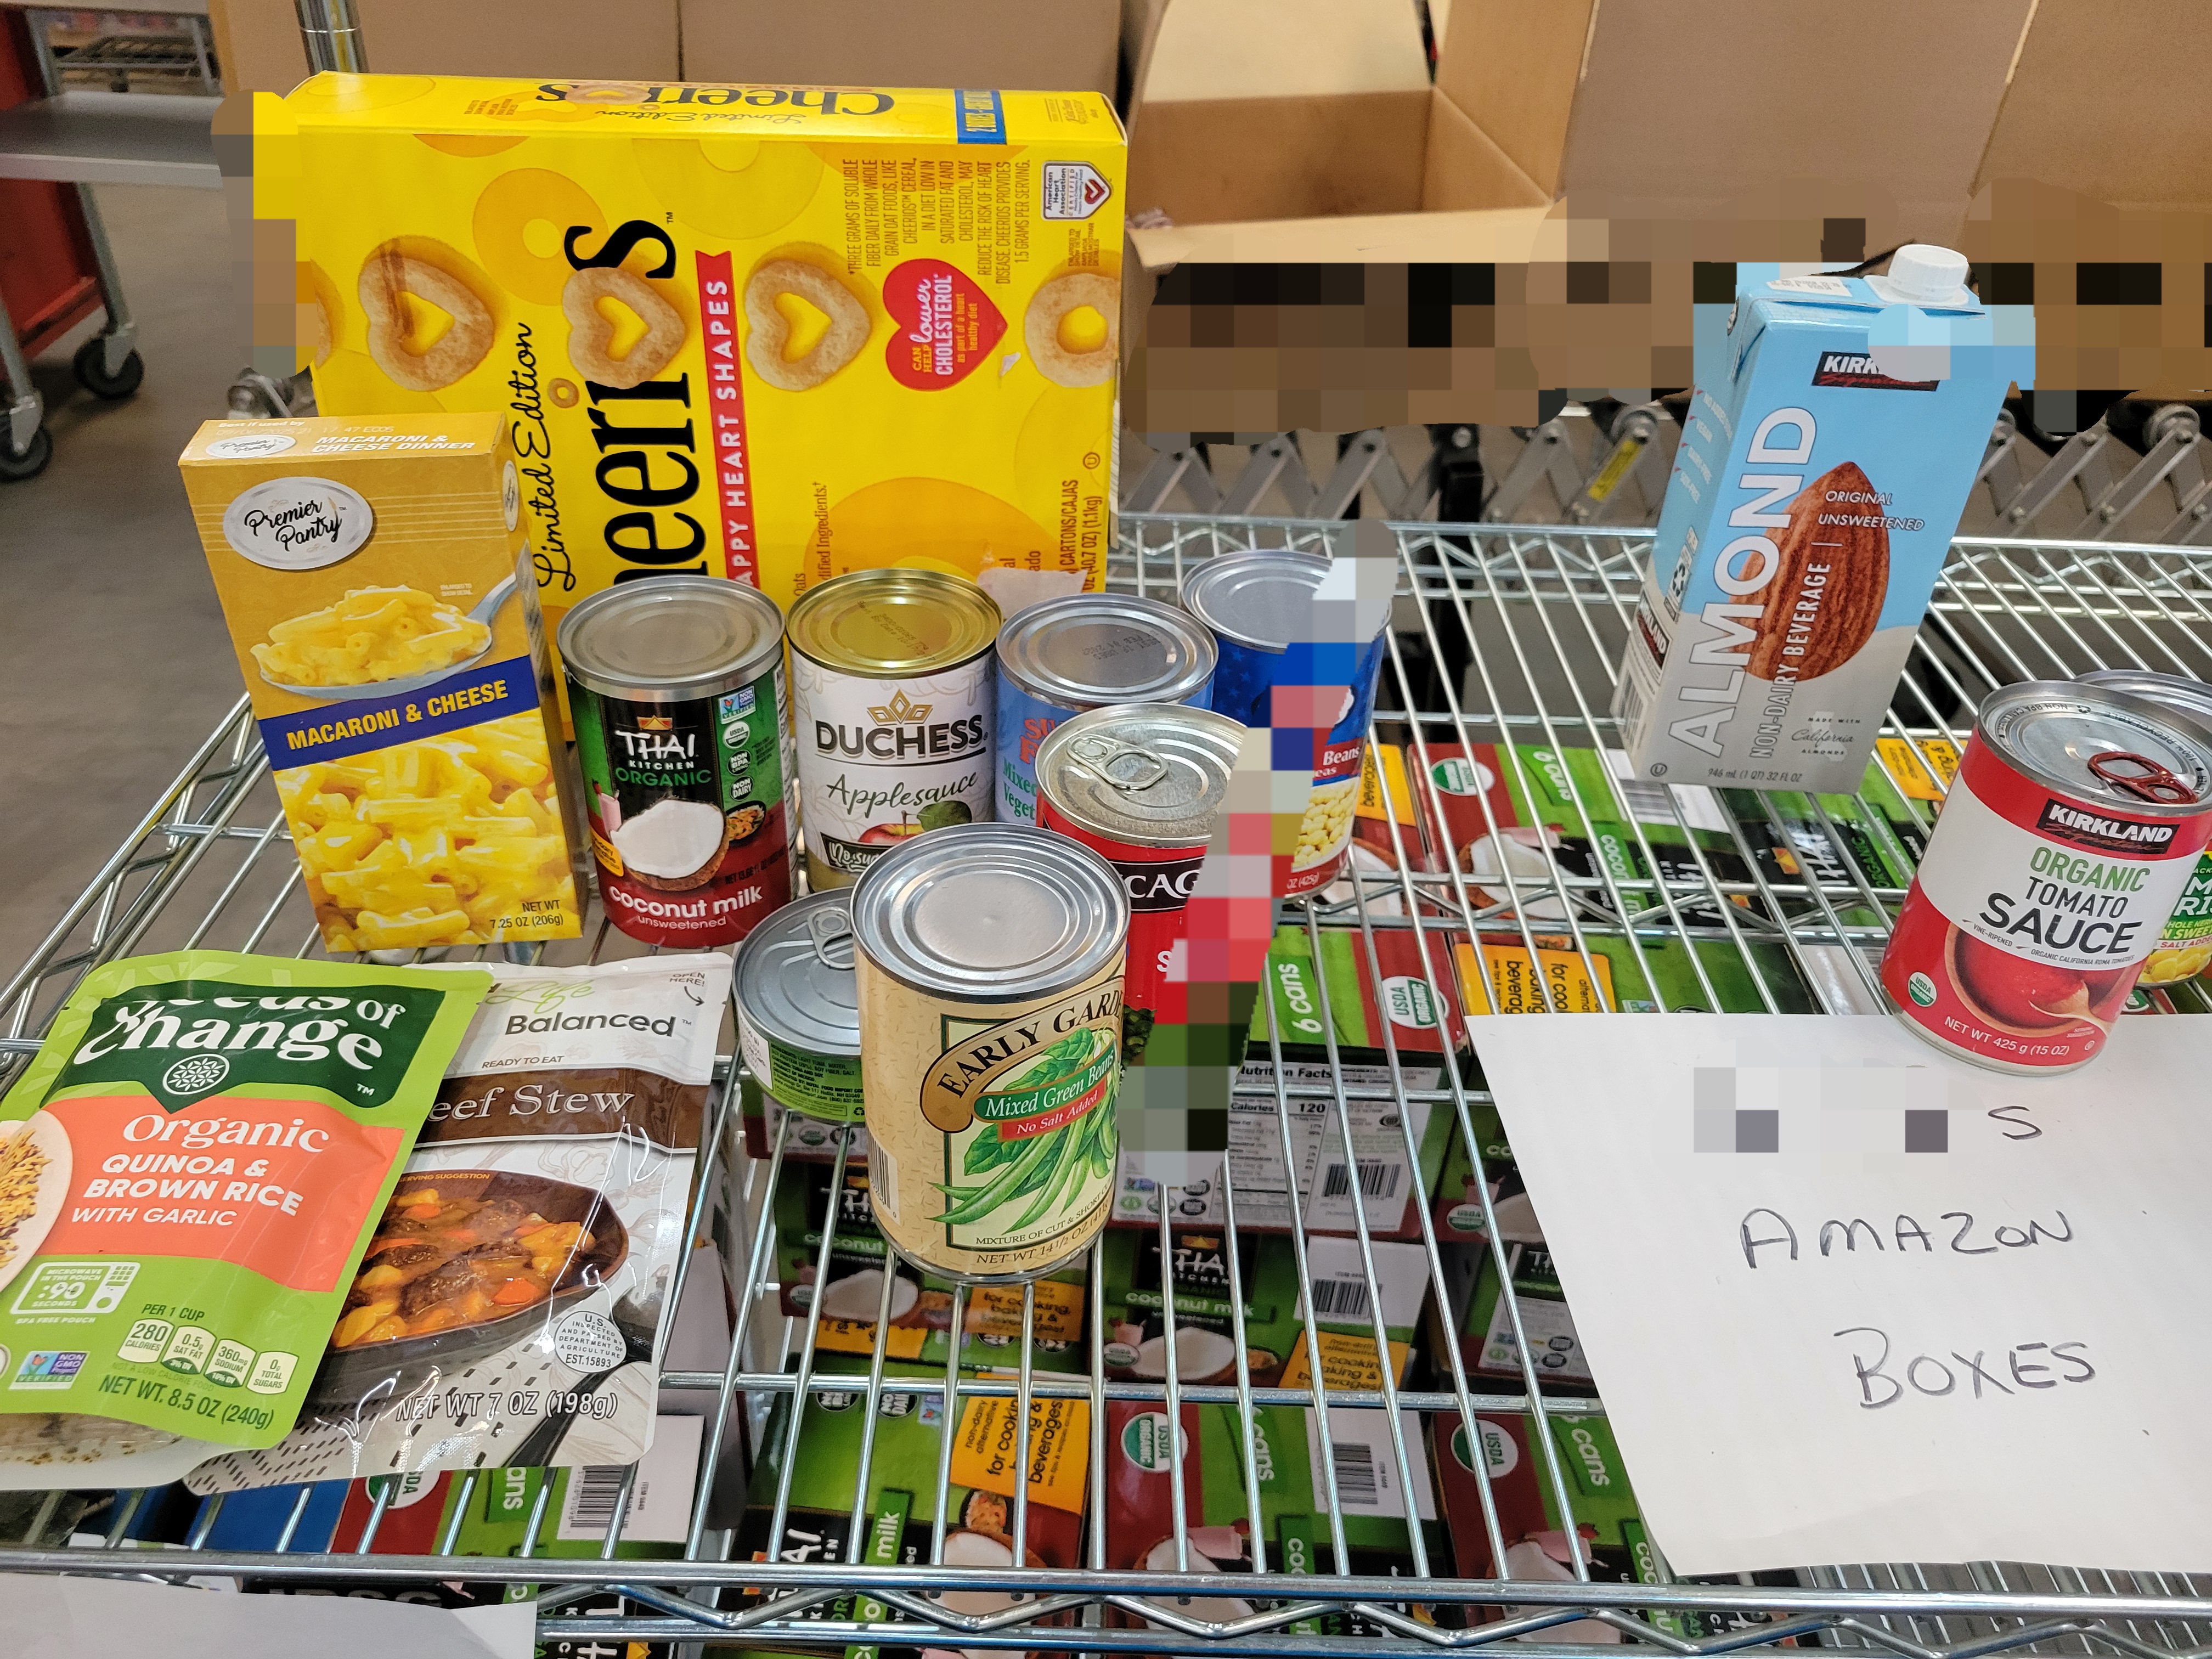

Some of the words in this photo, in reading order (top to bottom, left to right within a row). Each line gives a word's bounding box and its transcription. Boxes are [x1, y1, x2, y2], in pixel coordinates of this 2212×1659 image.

[535, 84, 894, 116] Cheeris
[594, 110, 697, 121] Edition
[700, 112, 805, 124] Limited
[843, 159, 859, 197] SOLUBLE
[863, 160, 878, 190] WHOLE
[882, 160, 896, 178] LIKE
[845, 200, 859, 210] OF
[865, 193, 878, 217] FROM
[883, 181, 898, 211] FOODS,
[846, 212, 860, 242] GRAMS
[865, 218, 880, 240] DAILY
[884, 214, 898, 228] OAT
[866, 243, 881, 266] FIBER
[884, 232, 899, 256] GRAIN
[909, 279, 933, 343] lower
[955, 293, 965, 314] heart
[968, 303, 977, 319] diet
[708, 280, 737, 400] SHAPES
[968, 321, 979, 351] healthy
[912, 347, 922, 370] CAN
[923, 345, 932, 373] HELP
[508, 322, 551, 459] Edition
[312, 444, 394, 453] CHEESE
[316, 436, 428, 444] MACARONI
[719, 415, 746, 506] HEART
[1081, 495, 1102, 528] (1.1kg)
[1825, 491, 1893, 506] ORIGINAL
[244, 499, 323, 537] Premier
[522, 462, 577, 592] Limited
[1818, 514, 1925, 531] UNSWEETENED
[275, 516, 342, 552] Pantry
[729, 522, 754, 586] APPY
[1668, 407, 1817, 758] ALMOND
[1749, 663, 1798, 759] NON-DAIRY
[1782, 562, 1831, 657] BEVERAGE
[286, 708, 399, 750] MACARONI
[405, 704, 423, 722] &
[427, 680, 509, 715] CHEESE
[730, 726, 744, 736] USDA
[815, 714, 984, 759] DUCHESS
[1791, 729, 1854, 748] California
[614, 730, 697, 760] THAI
[1323, 747, 1360, 766] Beans
[615, 767, 712, 786] ORGANIC
[629, 760, 695, 770] KITCHEN
[733, 783, 752, 798] DAIRY
[826, 771, 977, 819] Applesauce
[2048, 804, 2173, 844] KIRKLAND
[2030, 847, 2152, 892] ORGANIC
[521, 901, 541, 912] NET
[544, 899, 561, 911] WT
[609, 886, 708, 918] coconut
[713, 885, 763, 915] milk
[2025, 876, 2129, 918] TOMATO
[490, 917, 511, 929] 7.25
[515, 916, 529, 927] OZ
[532, 913, 565, 928] (206g)
[638, 915, 726, 929] unsweetened
[1978, 893, 2142, 954] SAUCE
[1973, 924, 2012, 947] VINE-RIPENED
[2030, 949, 2058, 961] ORGANIC
[2059, 955, 2093, 964] CALIFORNIA
[669, 978, 705, 987] HERE!
[1280, 962, 1312, 1014] cans
[1914, 975, 1932, 994] USDA
[1392, 984, 1408, 1016] USDA
[357, 1000, 406, 1029] of
[505, 1011, 676, 1037] Balanced
[1292, 1017, 1323, 1034] 6
[1945, 1016, 1969, 1036] NET
[1971, 1030, 1992, 1043] WT
[1993, 1038, 2017, 1052] 425
[2018, 1045, 2028, 1054] g
[2030, 1045, 2048, 1056] (15
[2050, 1045, 2070, 1056] OZ)
[482, 1057, 521, 1069] READY
[541, 1055, 565, 1063] EAT
[938, 1020, 1041, 1099] EARLY
[985, 1094, 1039, 1119] Mixed
[1043, 1076, 1085, 1110] Green
[1088, 1049, 1115, 1083] Beans
[427, 1086, 505, 1122] eef
[509, 1084, 635, 1116] Stew
[1017, 1121, 1037, 1135] No
[1039, 1113, 1064, 1131] Salt
[1067, 1090, 1098, 1119] Added
[1299, 1103, 1325, 1113] 120
[123, 1115, 330, 1154] Organic
[102, 1154, 236, 1176] QUINOA
[244, 1159, 270, 1177] &
[83, 1179, 220, 1200] BROWN
[232, 1181, 304, 1216] RICE
[71, 1208, 137, 1224] WITH
[143, 1209, 237, 1227] GARLIC
[977, 1234, 1026, 1244] MIXTURE
[1028, 1229, 1043, 1239] OF
[1045, 1221, 1065, 1234] CUT
[1076, 1194, 1100, 1219] SHORT
[977, 1254, 1009, 1263] NET
[1014, 1249, 1036, 1261] WT
[1072, 1223, 1088, 1240] OZ
[142, 1304, 169, 1316] PER
[179, 1308, 205, 1321] CUP
[585, 1314, 606, 1328] U.S.
[125, 1340, 161, 1351] CALORIES
[131, 1323, 168, 1342] 280
[559, 1336, 611, 1348] DEPARTMENT
[173, 1346, 189, 1355] SAT
[190, 1350, 204, 1359] FAT
[560, 1344, 620, 1358] AGRICULTURE
[566, 1353, 611, 1368] EST.15893
[215, 1358, 244, 1372] SODIUM
[261, 1370, 283, 1379] TOTAL
[1833, 1326, 2096, 1408] BOXES
[253, 1379, 283, 1389] SUGARS
[99, 1374, 137, 1395] NET
[137, 1380, 166, 1403] WT.
[167, 1389, 196, 1410] 8.5
[198, 1397, 222, 1418] OZ
[221, 1403, 274, 1430] (240g)
[396, 1395, 442, 1421] NET
[446, 1393, 484, 1417] WT
[489, 1393, 504, 1420] 7
[507, 1392, 539, 1415] OZ
[545, 1391, 618, 1420] (198g)
[1029, 1403, 1063, 1484] beverages
[1485, 1433, 1505, 1467] USDA
[987, 1456, 1006, 1476] for
[1572, 1430, 1610, 1488] cans
[876, 1512, 900, 1558] milk
